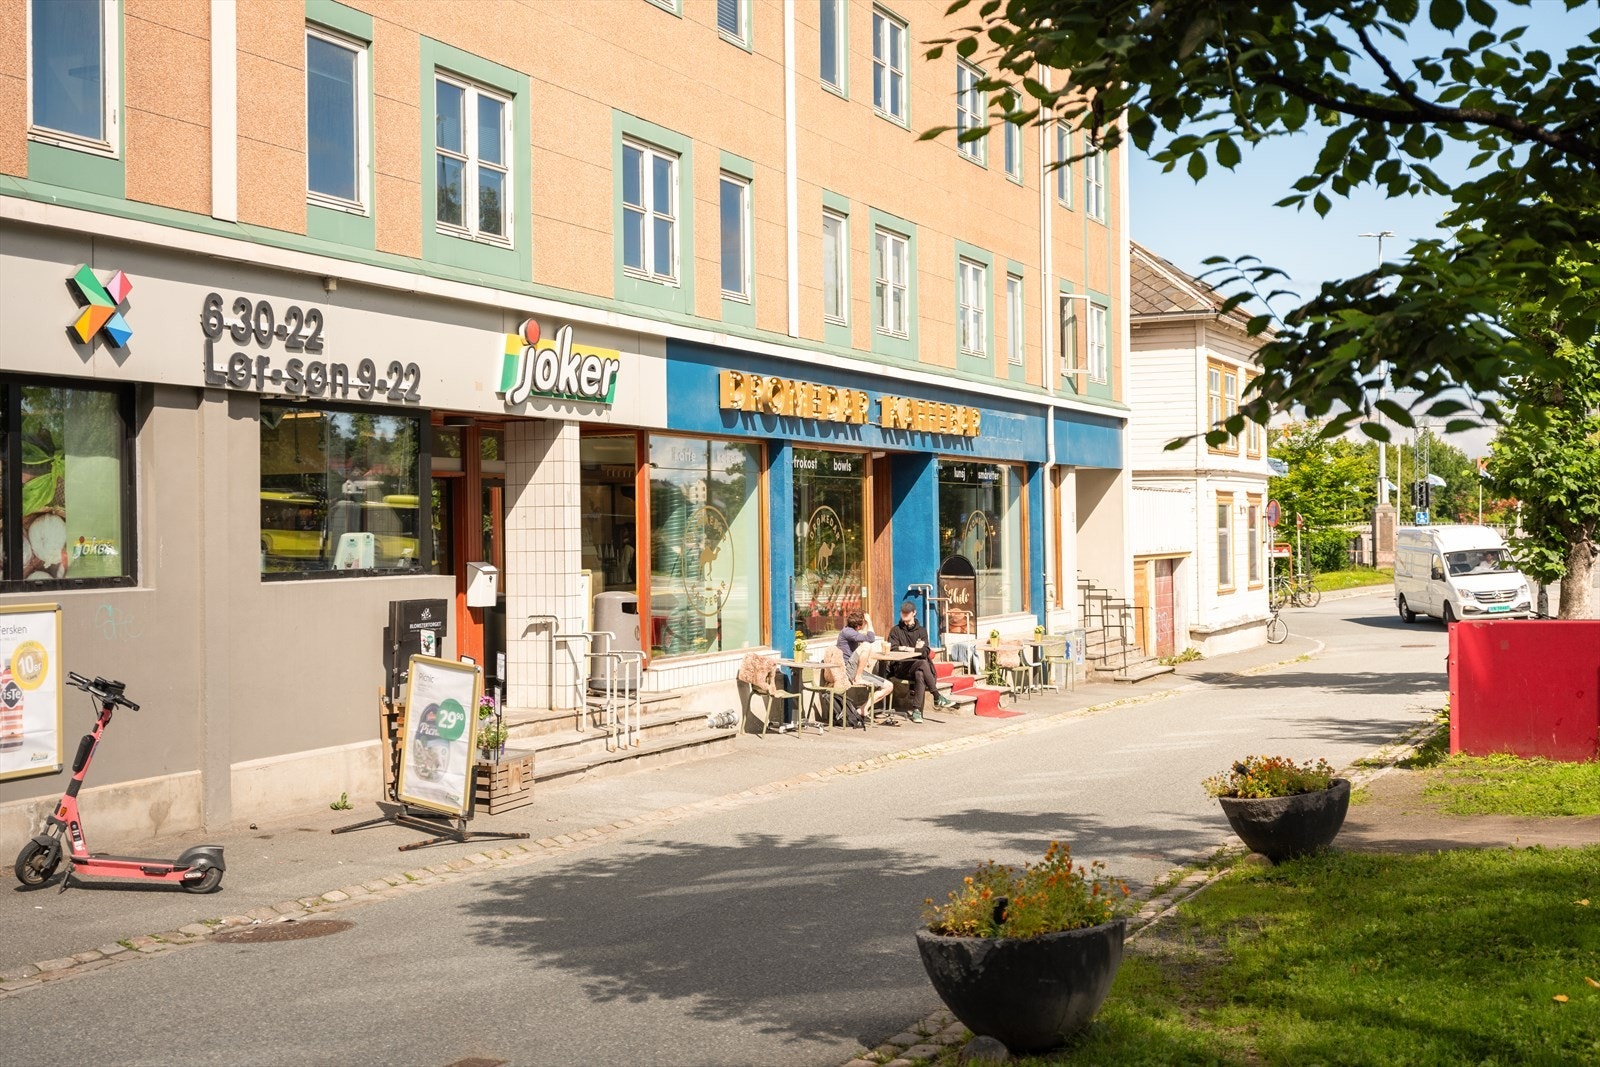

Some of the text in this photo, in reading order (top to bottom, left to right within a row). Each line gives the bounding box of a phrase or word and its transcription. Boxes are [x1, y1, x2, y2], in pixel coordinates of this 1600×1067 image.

[357, 358, 421, 401] 9-22
[504, 317, 620, 406] joker
[719, 370, 870, 425] DROMEDAR
[880, 395, 981, 437] KAFFEBAR
[793, 454, 818, 470] frokost
[833, 457, 852, 472] bowls
[809, 514, 841, 541] DROMEDAR
[0, 624, 28, 636] ersken
